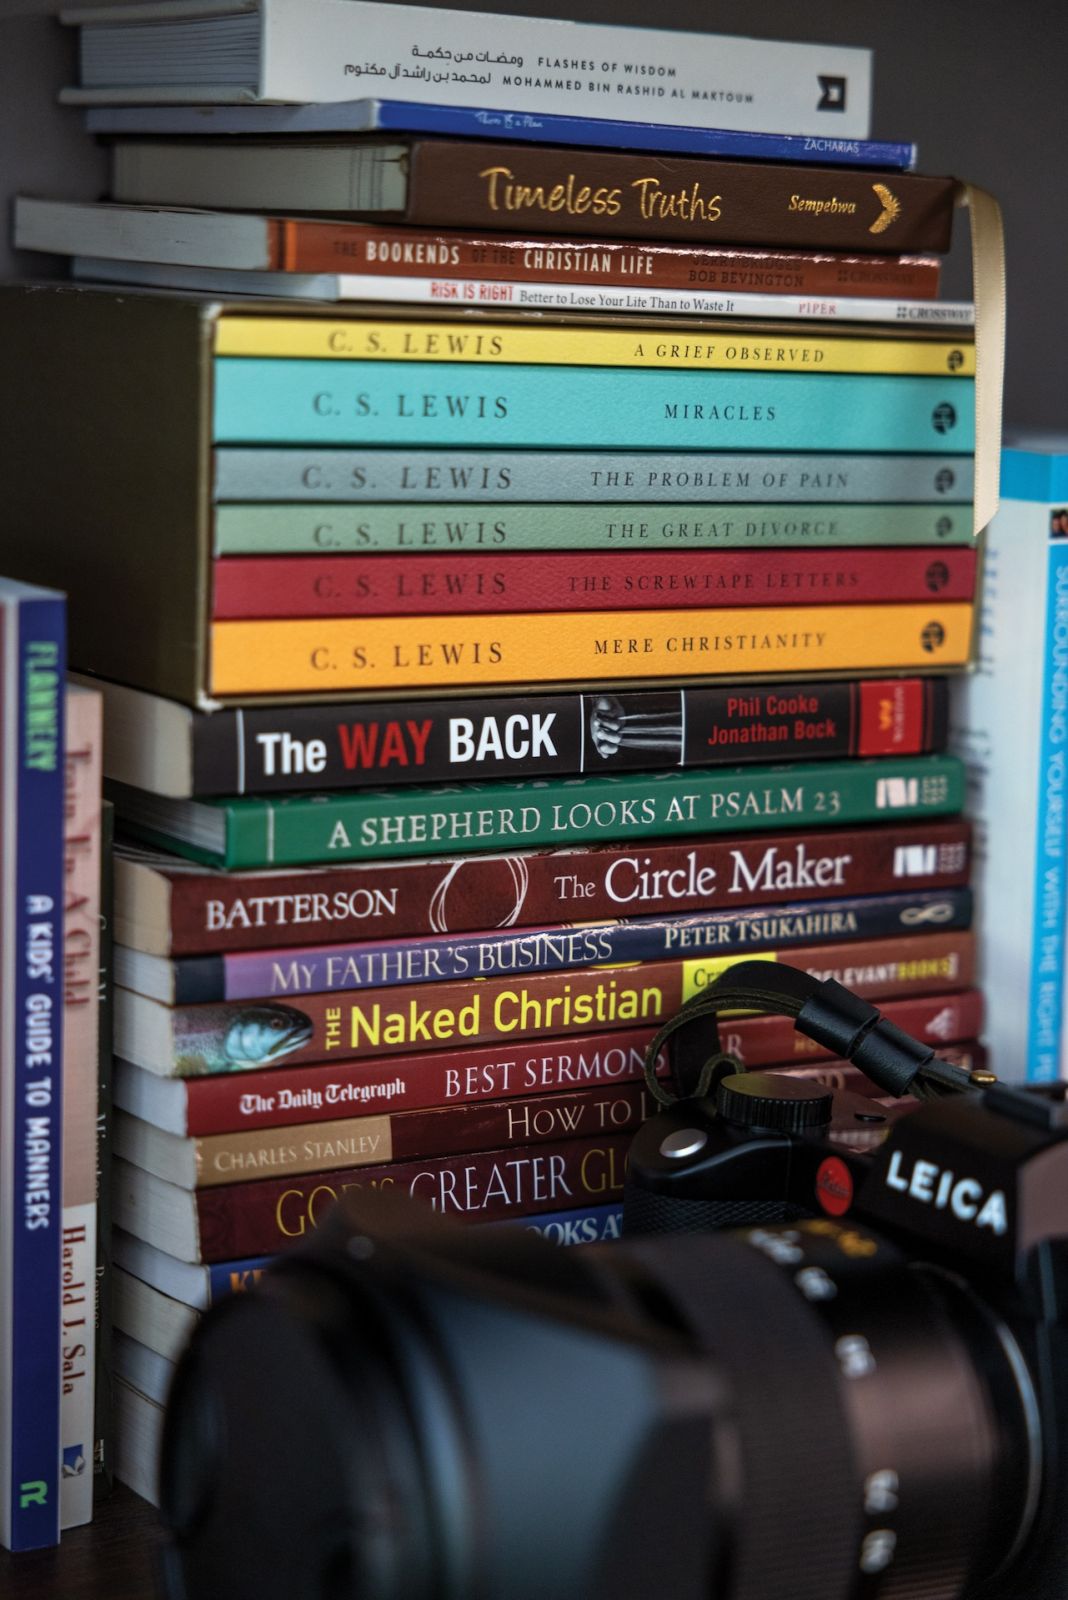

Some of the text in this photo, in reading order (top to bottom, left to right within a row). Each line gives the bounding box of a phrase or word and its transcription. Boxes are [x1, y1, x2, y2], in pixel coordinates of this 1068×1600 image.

[344, 63, 386, 77] مكتوم
[454, 51, 474, 63] من
[537, 57, 677, 78] FLASHES OF WISDOM
[402, 65, 431, 82] راشد
[433, 73, 449, 84] بن
[452, 72, 491, 85] لمحمد
[502, 75, 754, 105] MOHAMMED BIN RASHID AL MAKTOUM
[804, 137, 860, 154] ZACHARIAS
[480, 166, 722, 221] Timeless Truths
[365, 239, 461, 266] BOOKENDS
[490, 249, 516, 265] THE
[523, 249, 611, 274] CHRISTIAN
[620, 255, 654, 276] LIFE
[688, 269, 804, 287] BOB BEVINGTON
[431, 281, 734, 313] RISK IS RIGHT Better to Lose Your Life Than to Waste It
[798, 302, 837, 316] PIPER
[327, 330, 504, 356] C. S. LEWIS
[633, 344, 826, 364] A GRIEF OBSERVED
[312, 391, 508, 419] C. S. LEWIS
[664, 403, 777, 422] MIRACLES
[302, 465, 512, 490] C. S. LEWIS
[591, 470, 849, 489] THE PROBLEM OF PAIN
[313, 521, 507, 547] C. S. LEWIS
[605, 520, 840, 539] THE GREAT DIVORCE
[312, 572, 506, 598] C. S. LEWIS
[567, 570, 860, 592] THE SCREWTAPE LETTERS
[309, 642, 503, 671] C. S. LEWIS
[594, 632, 828, 656] MERE CHRISTIANITY
[727, 694, 819, 718] Phil Cooke
[255, 712, 559, 776] The WAY BACK
[708, 717, 837, 746] Jonathan Bock
[327, 787, 841, 849] A SHEPHERD LOOKS AT PSALM 23
[553, 843, 853, 904] The Circle Maker
[25, 895, 54, 915] A
[205, 887, 399, 932] BATTERSON
[664, 911, 858, 949] PETER TSUKAHIRA
[478, 931, 614, 973] BUSINESS
[325, 980, 663, 1050] THE Naked Christian
[25, 993, 53, 1069] GUIDE
[24, 1075, 52, 1108] TO
[445, 1061, 516, 1098] BEST
[239, 1077, 406, 1115] The Daily Telegraph
[24, 1115, 52, 1232] MANNERS
[409, 1154, 573, 1214] GREATER
[885, 1150, 1009, 1238] LEICA
[62, 1224, 87, 1396] Harold J. Sala
